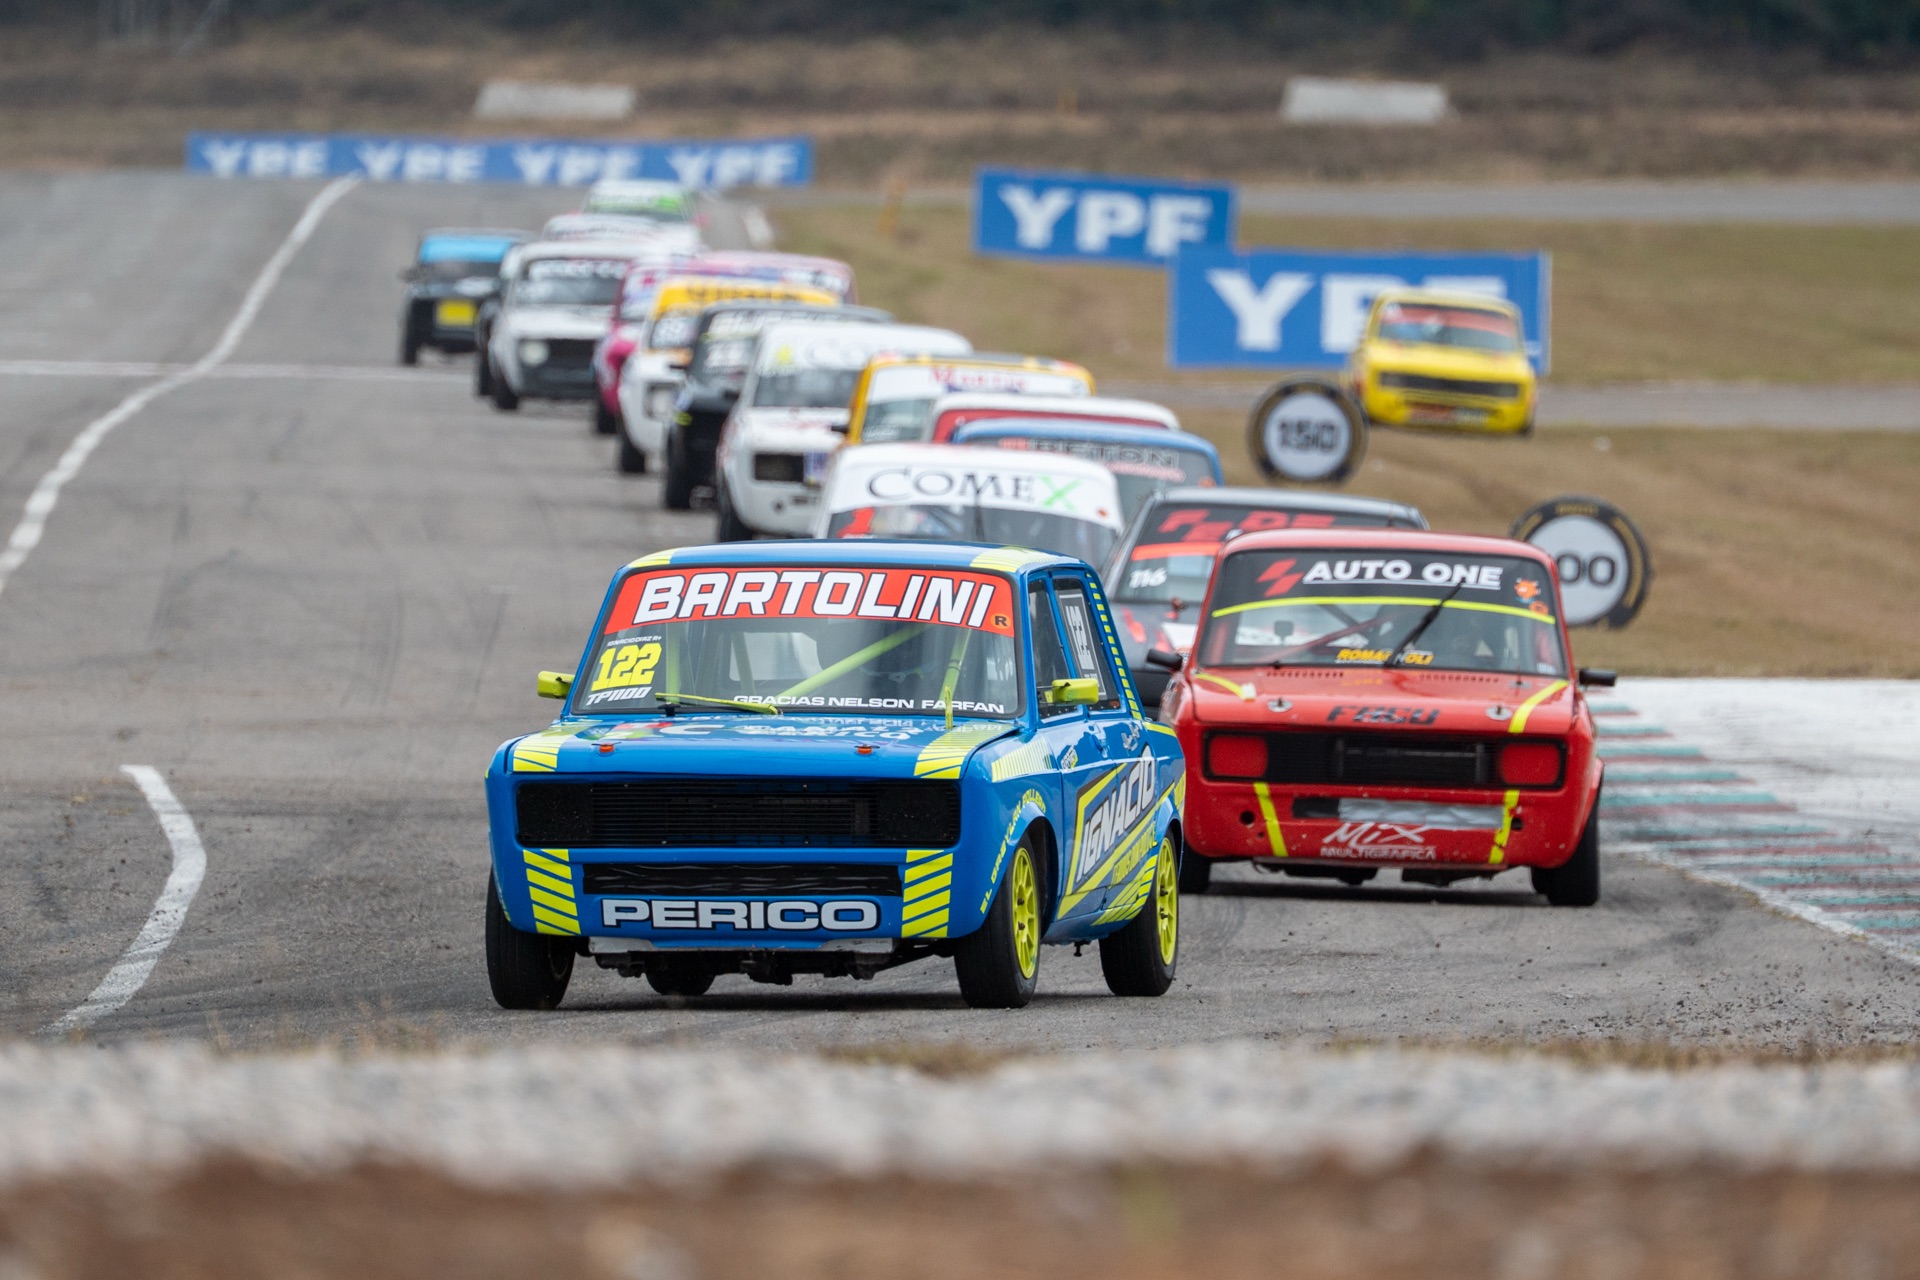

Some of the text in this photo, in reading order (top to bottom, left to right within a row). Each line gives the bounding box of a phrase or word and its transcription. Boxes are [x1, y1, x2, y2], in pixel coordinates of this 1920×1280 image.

[999, 184, 1213, 256] YPF
[1206, 269, 1507, 352] YP
[868, 468, 1081, 511] COMEX
[1302, 559, 1503, 587] AUTO ONE
[633, 570, 996, 629] BARTOLINI
[591, 643, 662, 692] 122
[734, 695, 1005, 714] GRACIAS NELSON FARFAN
[1077, 745, 1155, 883] IGNACIO
[601, 898, 879, 932] PERICO
